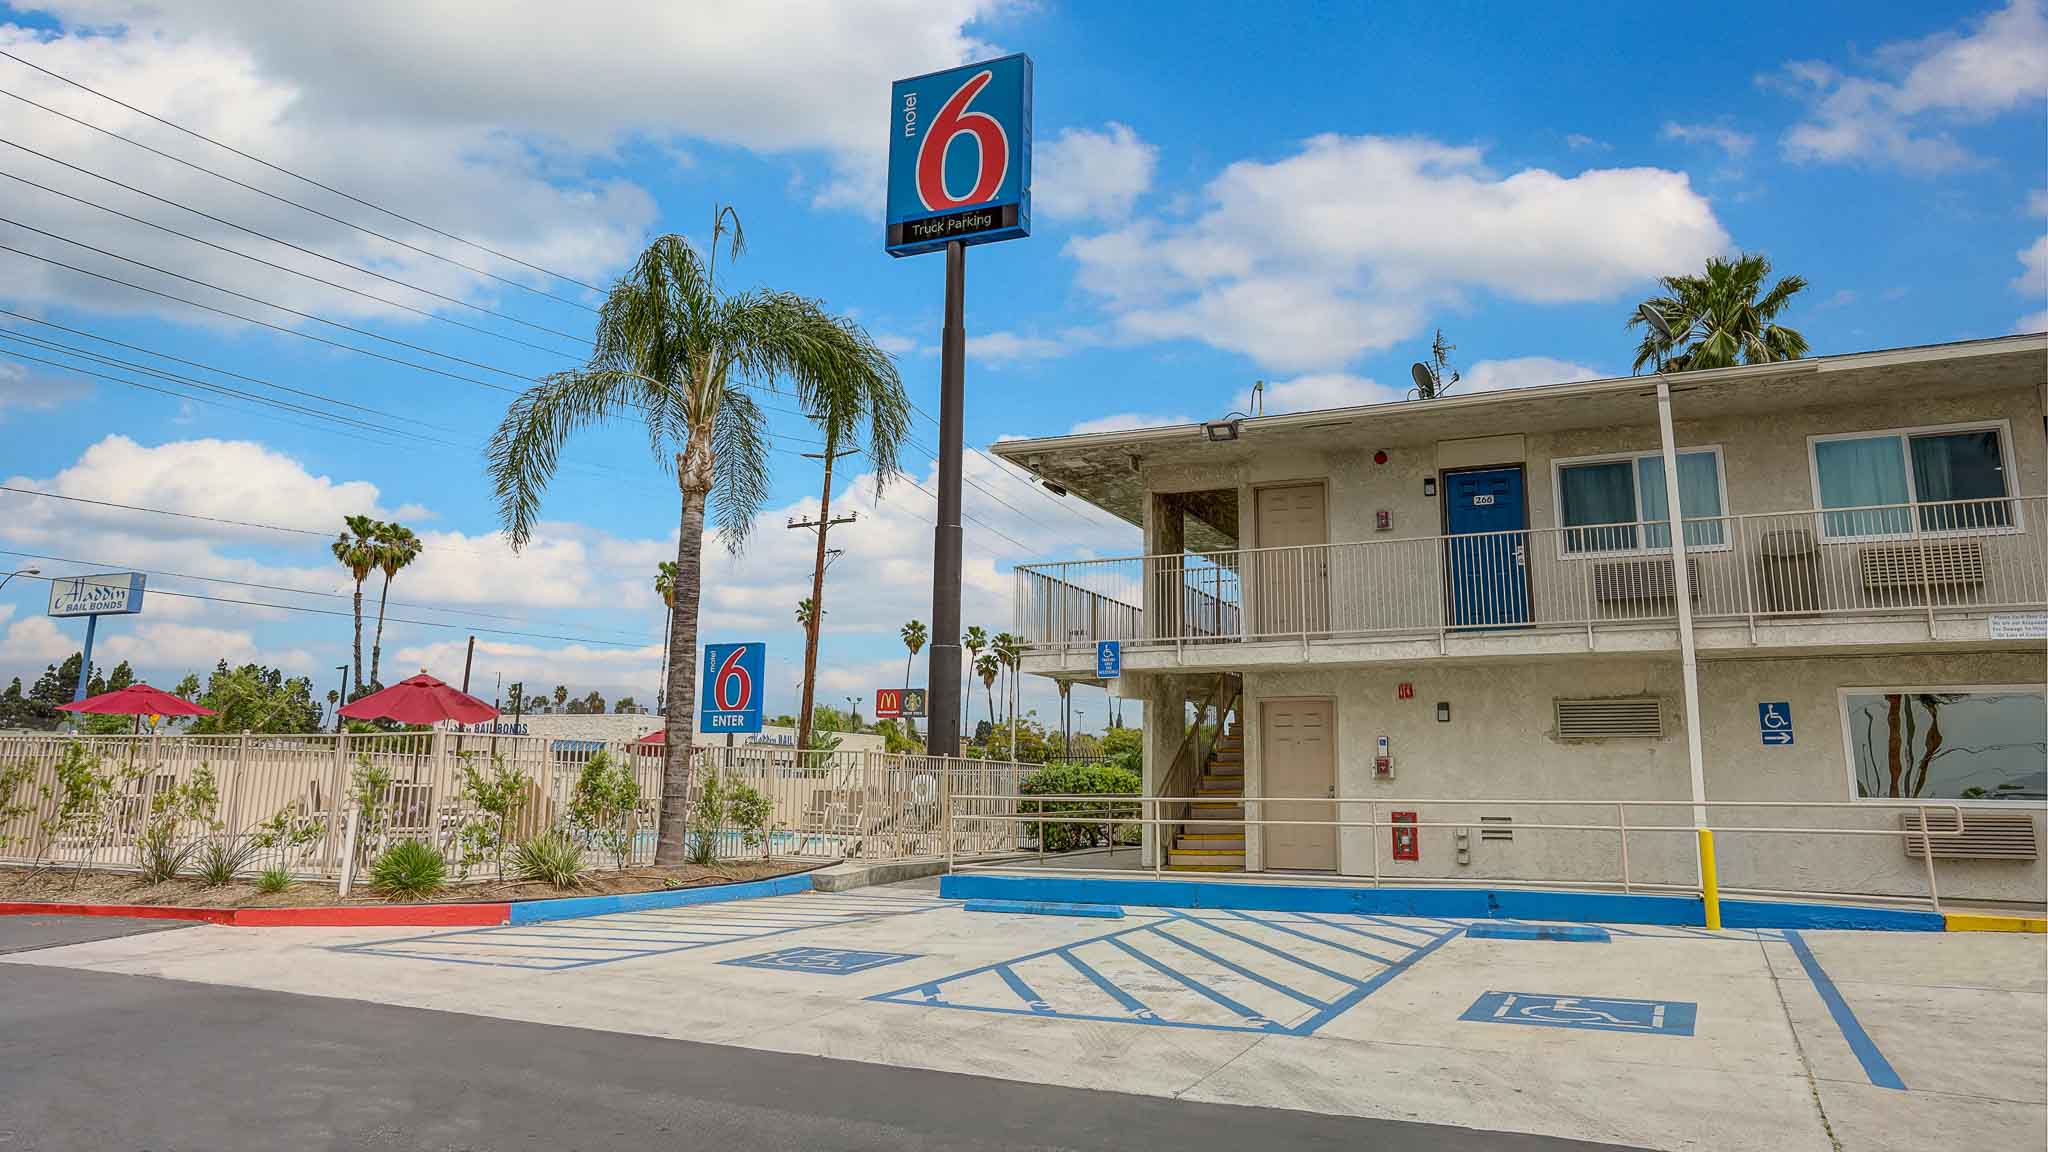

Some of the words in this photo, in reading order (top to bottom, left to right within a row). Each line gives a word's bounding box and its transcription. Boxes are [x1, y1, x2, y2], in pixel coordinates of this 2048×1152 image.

[903, 92, 918, 137] motel
[915, 70, 1009, 211] 6
[912, 222, 944, 236] Truck
[948, 214, 992, 231] Parking
[55, 578, 125, 609] Aladdin
[66, 602, 87, 612] BAIL
[89, 600, 122, 611] BONDS
[714, 646, 751, 711] 6
[475, 722, 494, 733] BAIL
[497, 723, 528, 734] BONDS
[712, 715, 744, 727] ENTER
